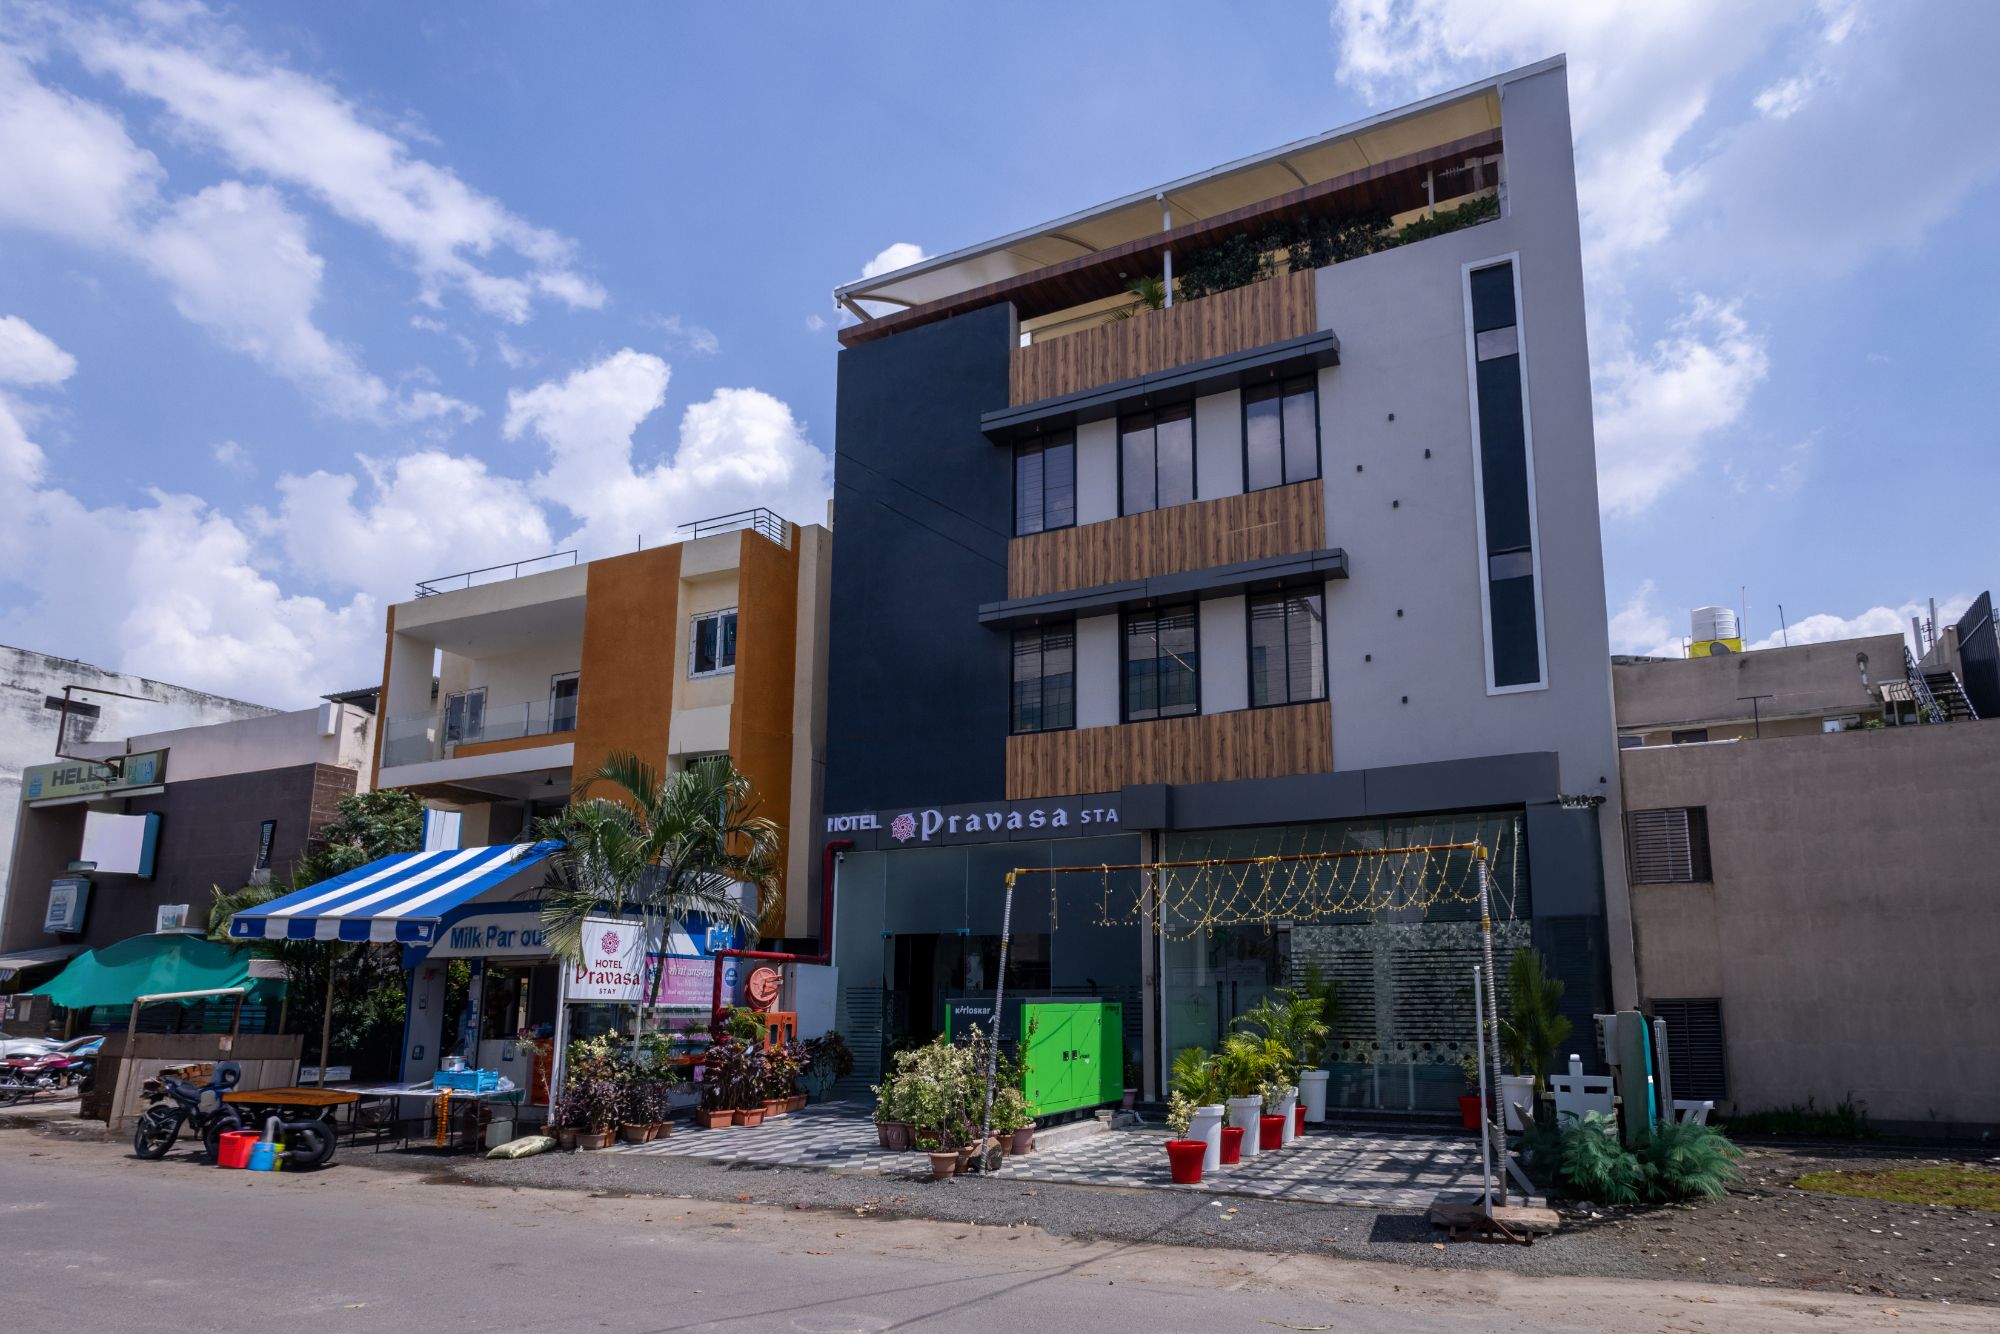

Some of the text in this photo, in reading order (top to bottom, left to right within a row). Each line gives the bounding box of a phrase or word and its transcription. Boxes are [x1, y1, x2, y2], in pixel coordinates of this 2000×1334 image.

[827, 808, 1119, 841] HOTEL Pravasa STA
[450, 927, 481, 948] Milk
[575, 962, 640, 985] Pravasa
[595, 960, 622, 969] HOTEL
